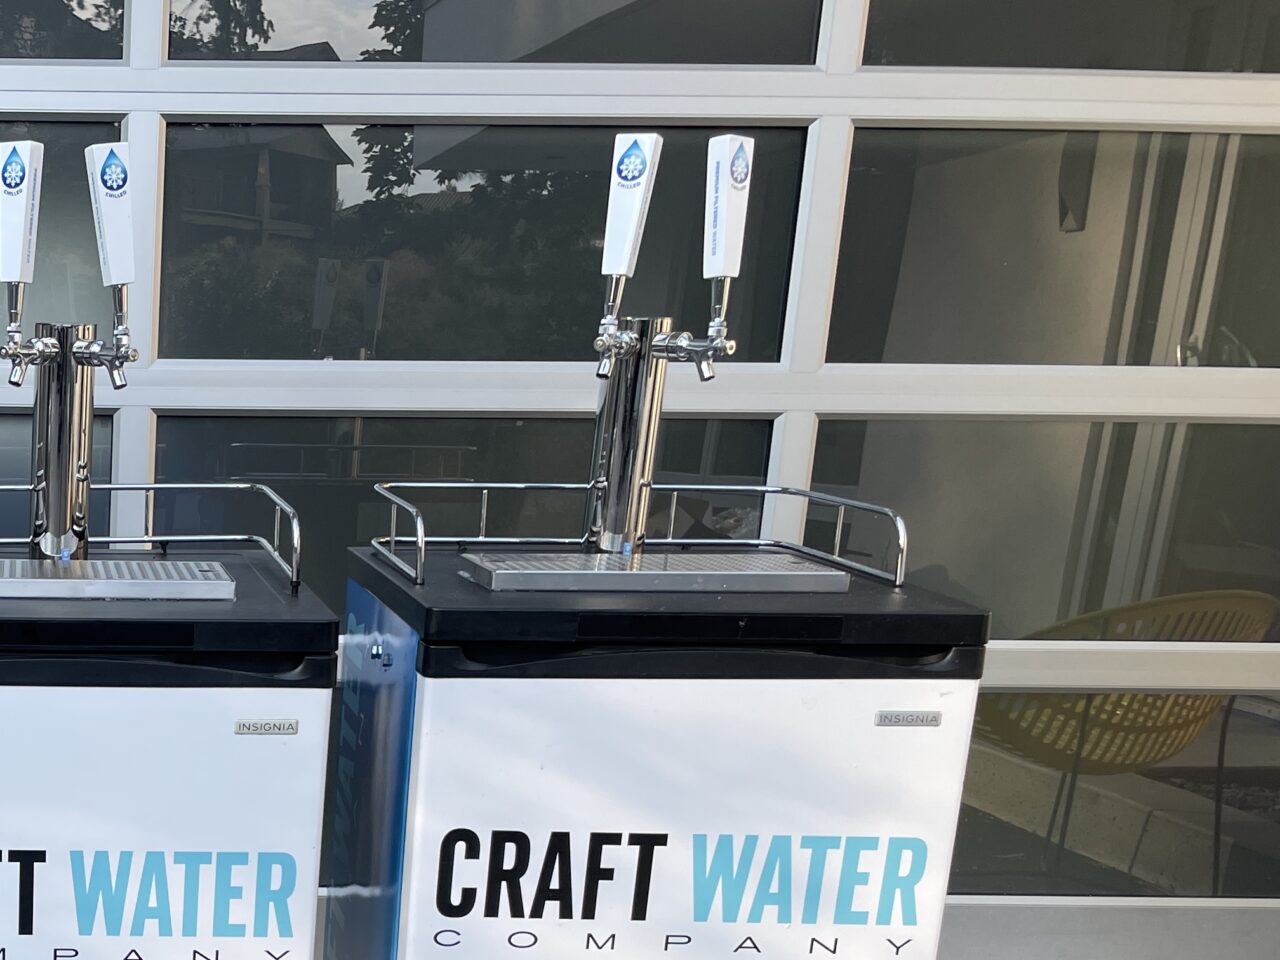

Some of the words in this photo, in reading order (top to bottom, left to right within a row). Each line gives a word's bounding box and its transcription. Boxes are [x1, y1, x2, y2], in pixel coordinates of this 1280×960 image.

[617, 181, 641, 190] CHILLED
[3, 188, 23, 197] CHILLED
[105, 190, 127, 199] CHILLED
[880, 714, 938, 724] INSIGNIA
[238, 722, 295, 732] INSIGNIA
[435, 827, 668, 921] CRAFT
[692, 833, 928, 926] WATER
[69, 849, 297, 938] WATER
[432, 929, 913, 956] COMPANY
